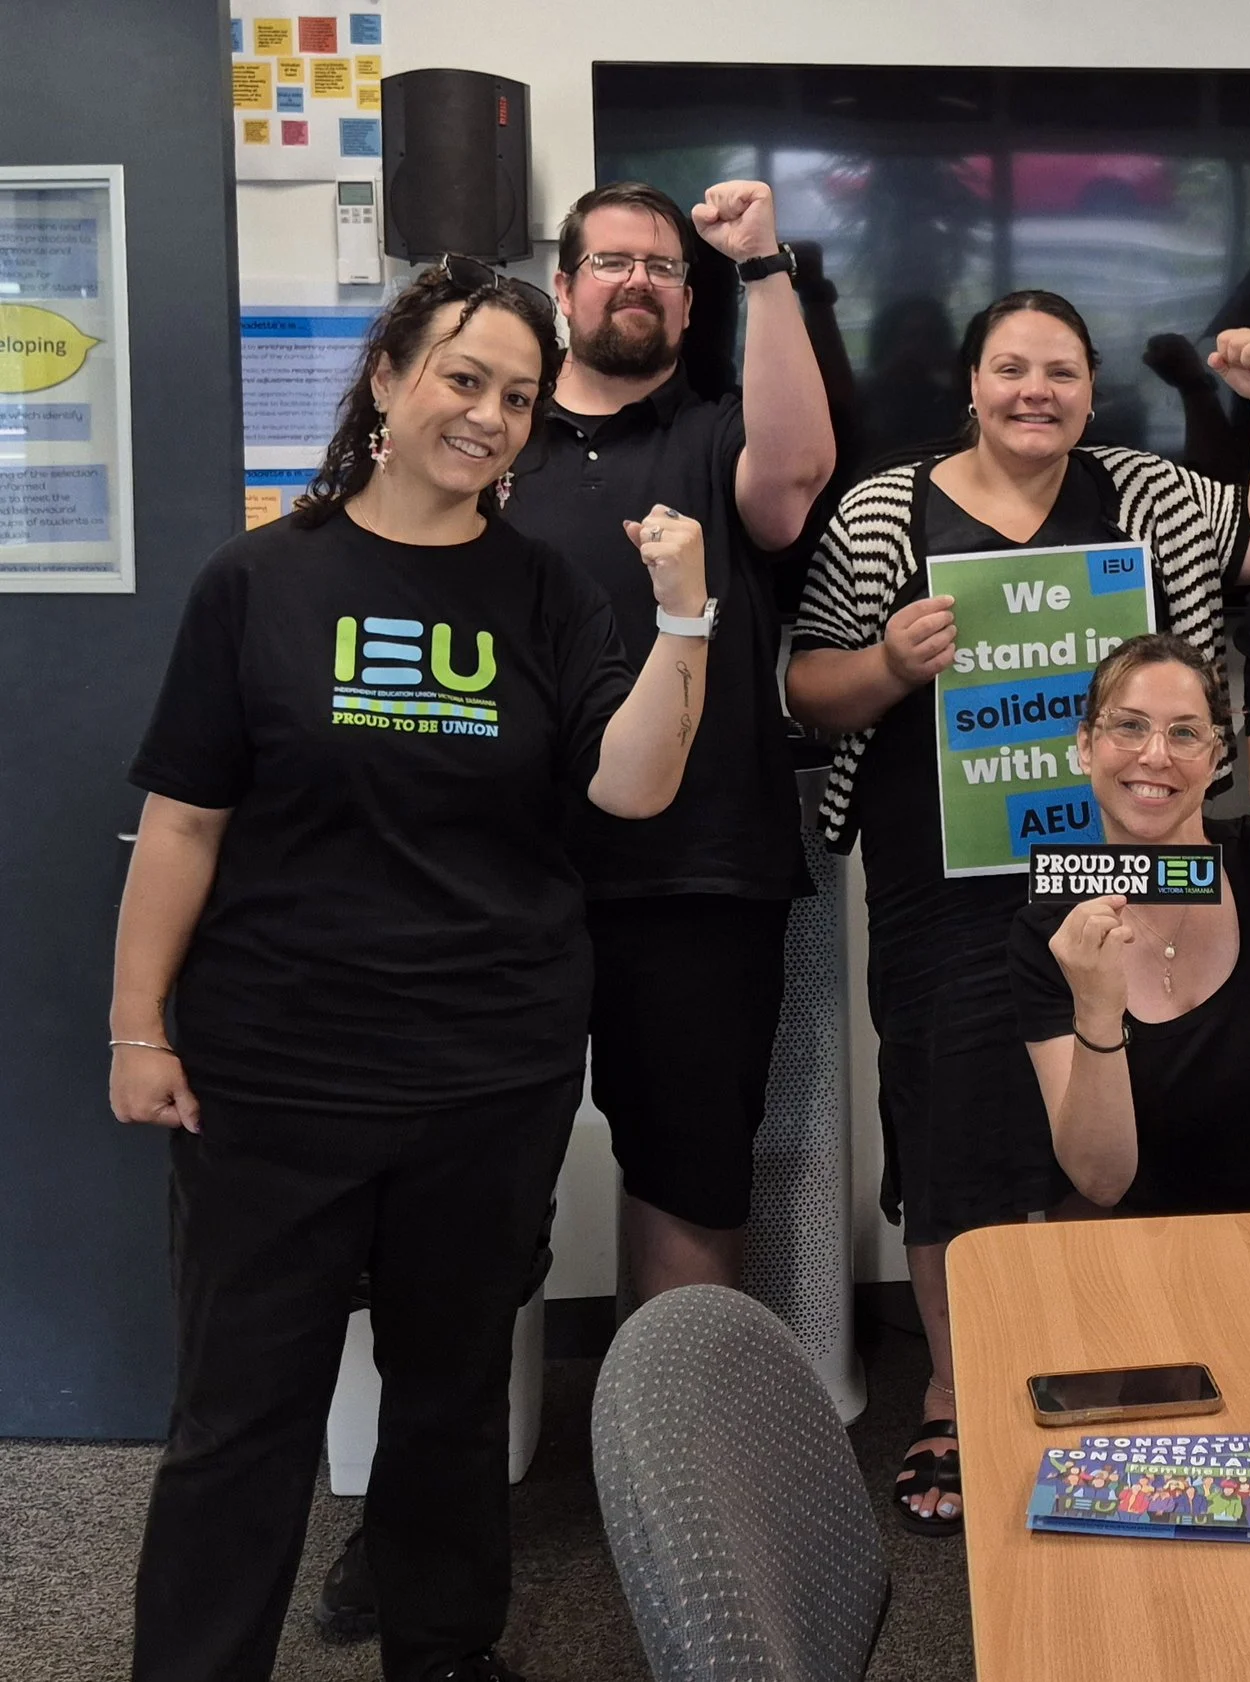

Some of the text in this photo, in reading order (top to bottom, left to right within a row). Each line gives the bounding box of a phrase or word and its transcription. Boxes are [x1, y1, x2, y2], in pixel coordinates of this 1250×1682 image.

[1102, 557, 1135, 575] IEU
[1002, 579, 1072, 614] We
[334, 616, 497, 692] IEU
[953, 631, 1078, 674] stand
[377, 690, 414, 698] EDUCATION
[332, 711, 499, 737] PROUD TO BE UNION
[956, 691, 1087, 733] solidar
[962, 746, 1059, 785] with
[1020, 800, 1092, 839] AEU
[1035, 854, 1151, 874] PROUD TO
[1158, 860, 1215, 887] IEU
[1035, 875, 1150, 895] BE UNION
[1129, 1465, 1247, 1476] From the IEU
[1064, 1498, 1117, 1512] IEU
